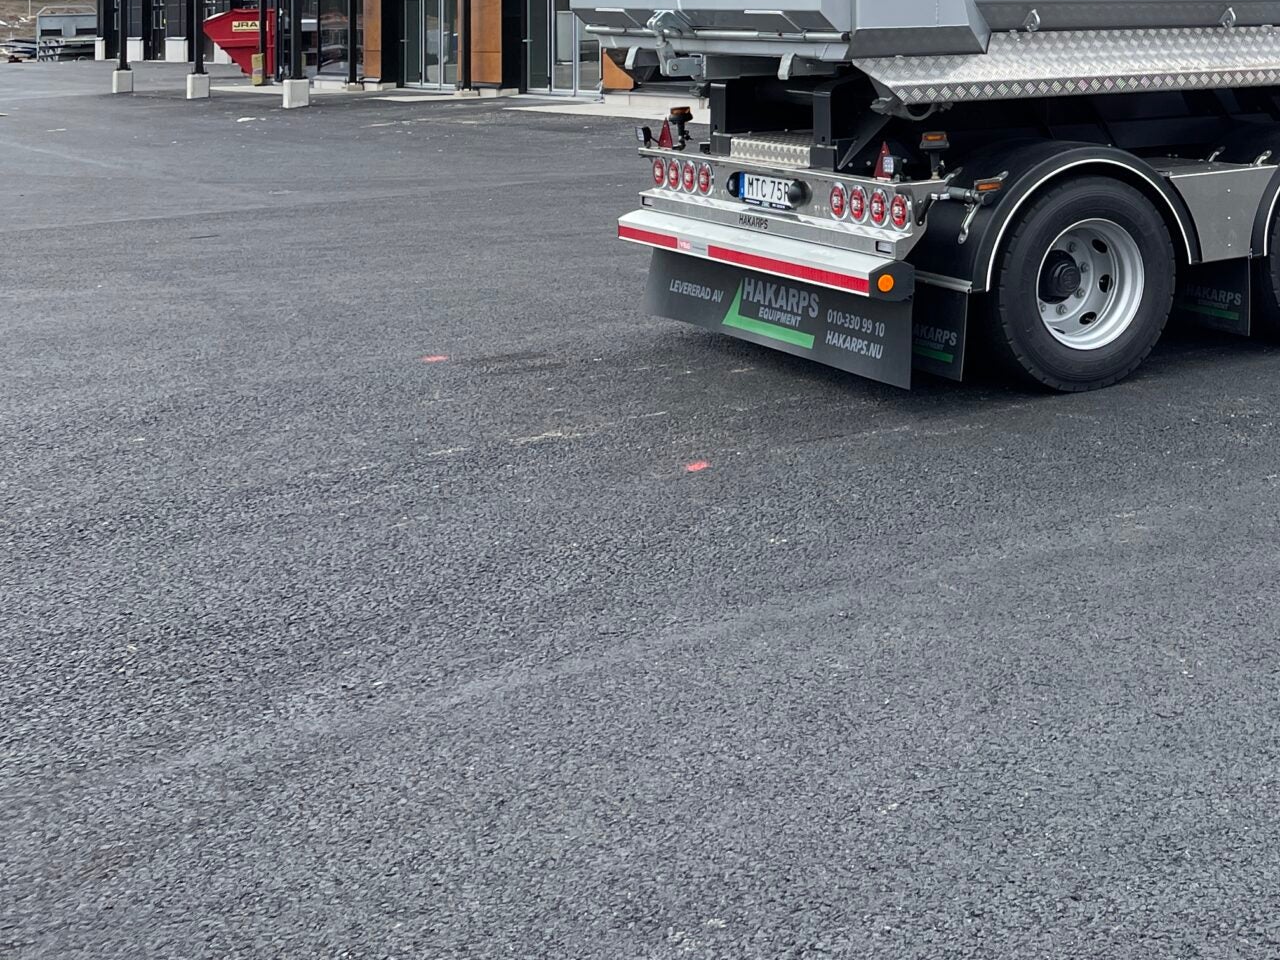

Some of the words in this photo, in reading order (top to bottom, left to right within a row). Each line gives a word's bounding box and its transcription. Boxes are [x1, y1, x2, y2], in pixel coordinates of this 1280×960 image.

[747, 176, 767, 198] MTC
[739, 214, 769, 230] HAKARPS
[669, 278, 711, 300] LEVERERAD
[711, 290, 724, 303] AV
[742, 277, 820, 319] HAKARPS
[758, 306, 801, 328] EQUIPMENT
[827, 309, 861, 331] 010-330
[861, 318, 873, 333] 99
[874, 322, 885, 337] 10
[825, 330, 884, 359] HAKARPS.NU
[913, 323, 958, 346] AKARPS
